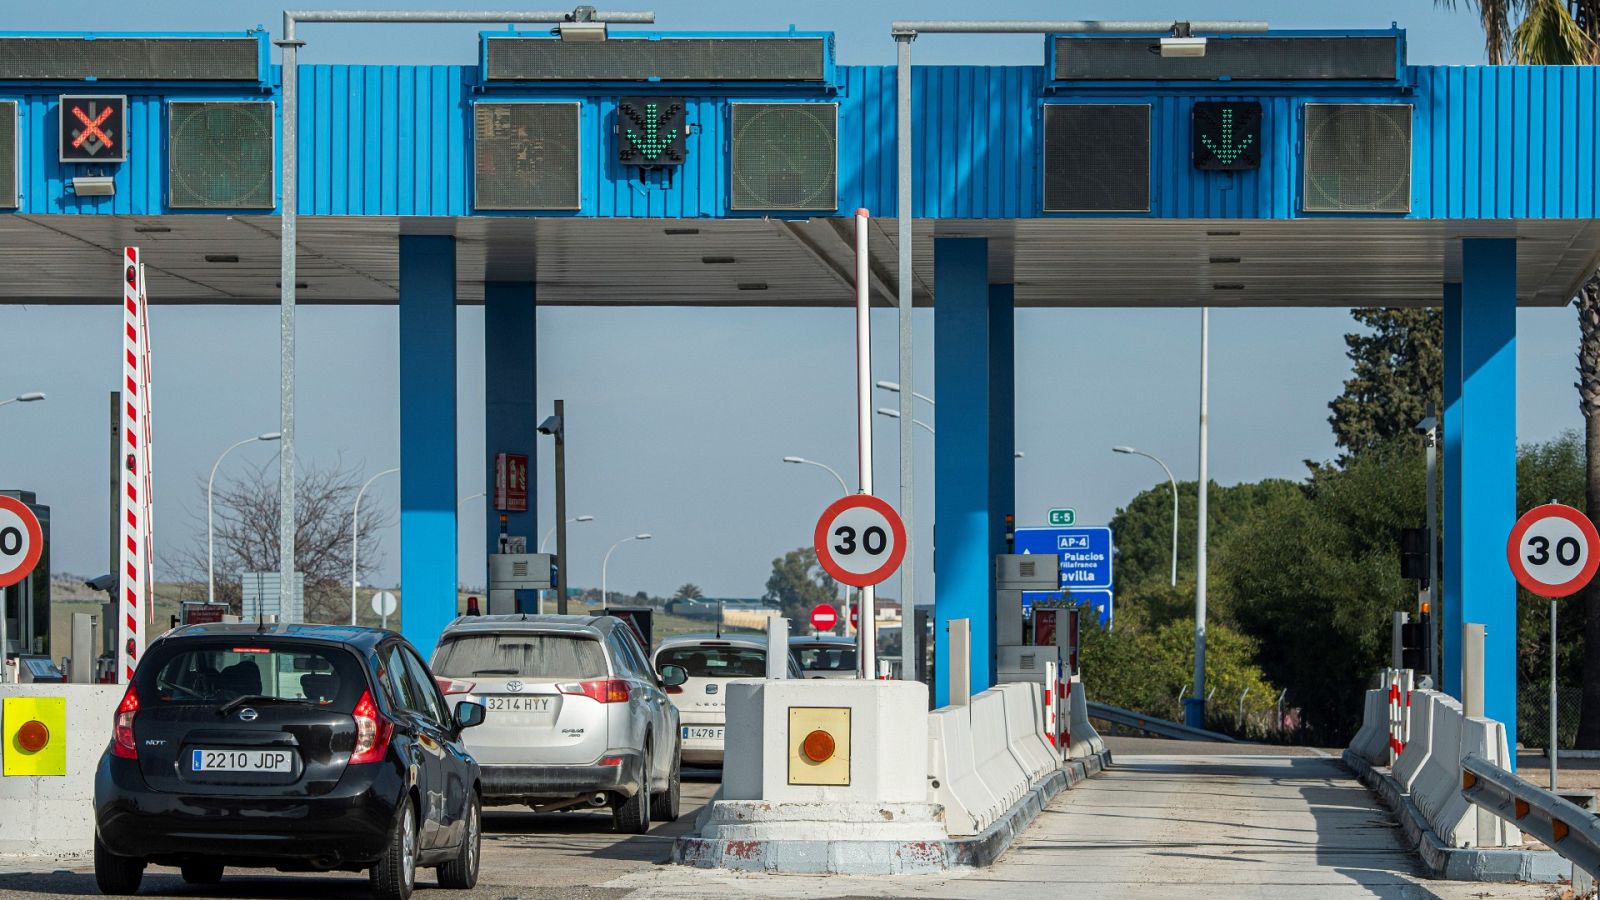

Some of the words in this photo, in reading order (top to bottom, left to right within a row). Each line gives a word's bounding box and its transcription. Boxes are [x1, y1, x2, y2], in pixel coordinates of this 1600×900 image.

[1052, 512, 1071, 522] E-5
[834, 526, 887, 555] 30
[1060, 537, 1087, 547] AP-4
[1064, 552, 1105, 561] Palacios
[1527, 535, 1581, 566] 30
[1061, 570, 1095, 582] evilla
[488, 698, 520, 711] 3214
[524, 698, 549, 711] HYY
[690, 728, 714, 738] 1478
[206, 752, 248, 769] 2210
[254, 753, 285, 769] JDP
